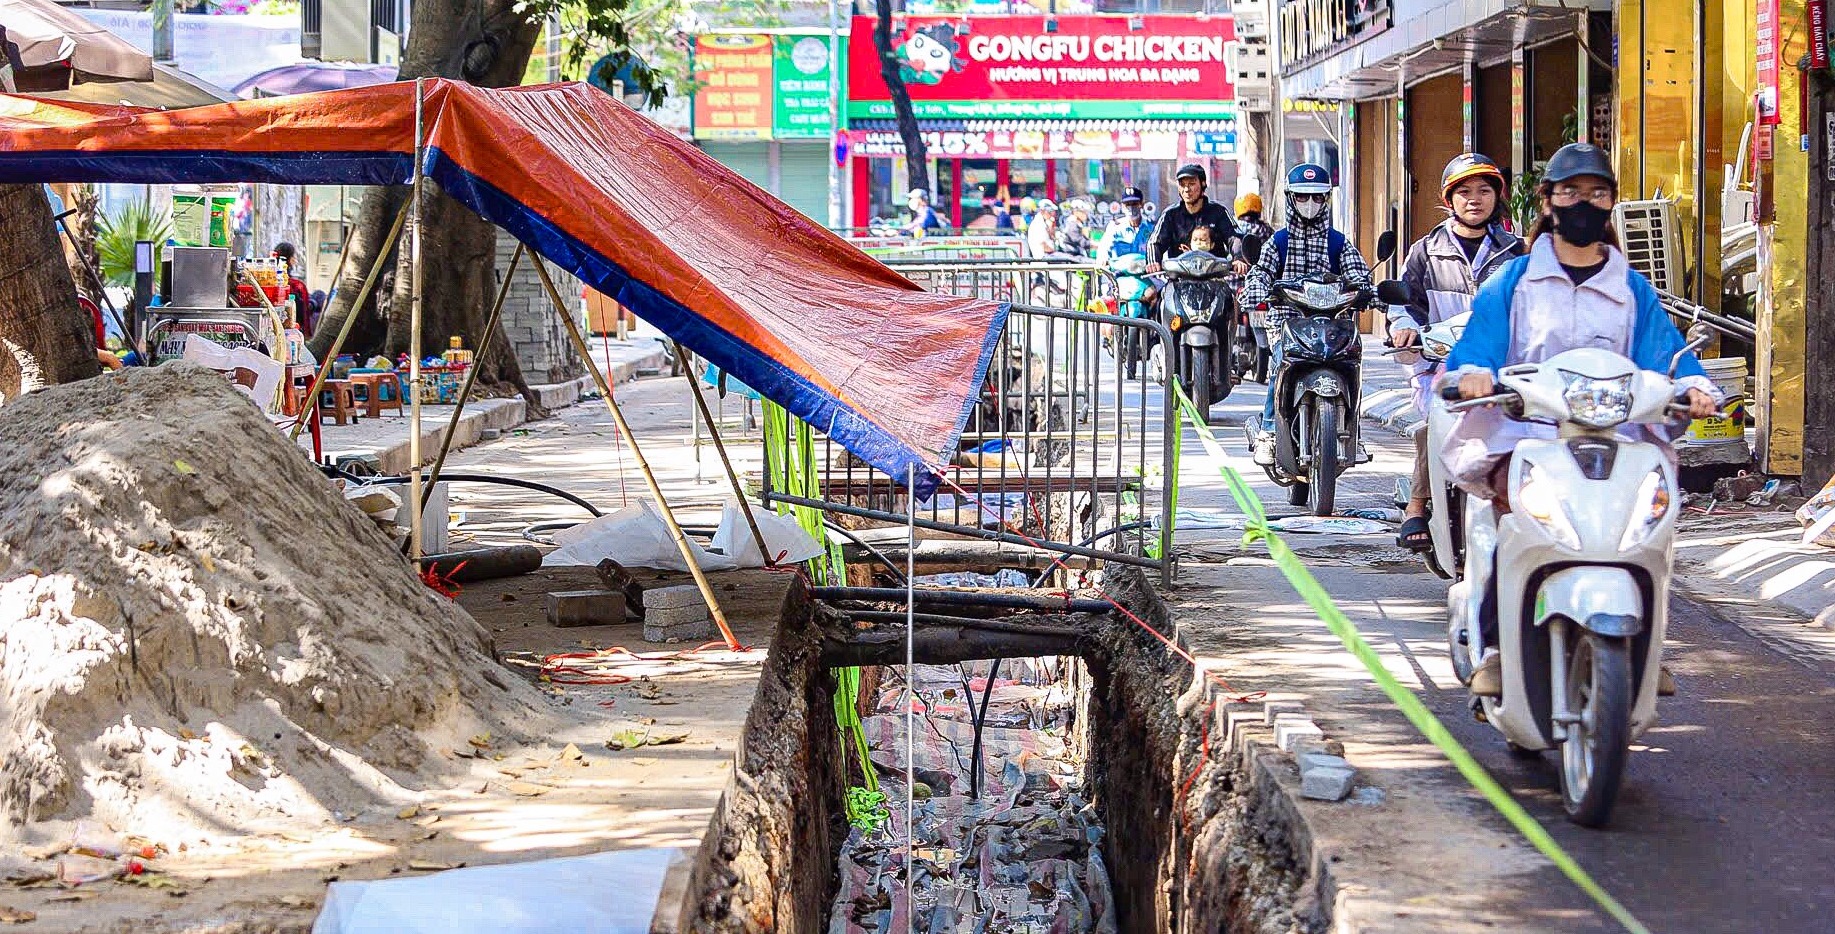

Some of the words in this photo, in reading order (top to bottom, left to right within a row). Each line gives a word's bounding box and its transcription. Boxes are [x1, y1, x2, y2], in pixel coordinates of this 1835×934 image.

[968, 34, 1091, 62] GONGFU
[1093, 34, 1223, 62] CHICKEN
[1042, 67, 1057, 85] VỊ
[1058, 67, 1107, 82] TRUNG
[1108, 67, 1139, 82] HOA
[1161, 67, 1200, 85] DẠNG
